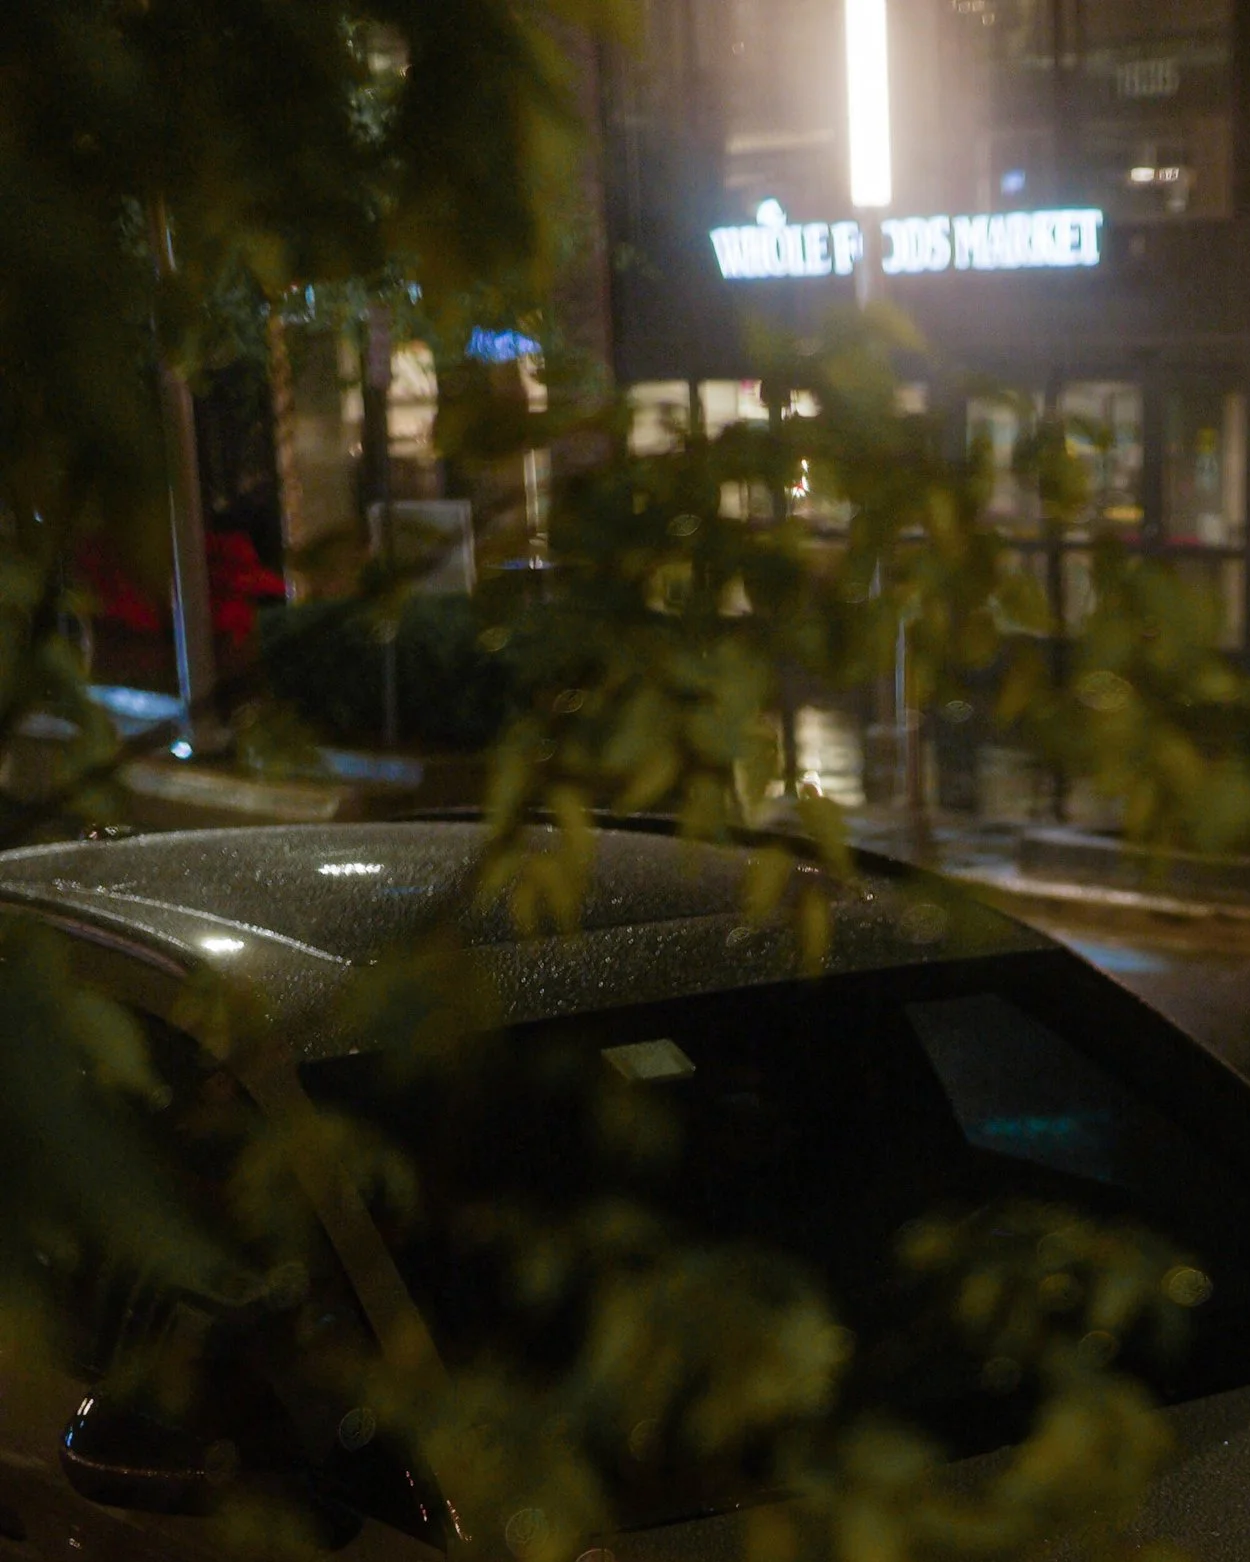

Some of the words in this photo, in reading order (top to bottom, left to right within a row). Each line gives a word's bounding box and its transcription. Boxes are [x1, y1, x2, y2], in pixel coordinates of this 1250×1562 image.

[710, 220, 831, 279] WHOLE
[832, 216, 951, 274] FODS
[953, 209, 1103, 270] MARKET
